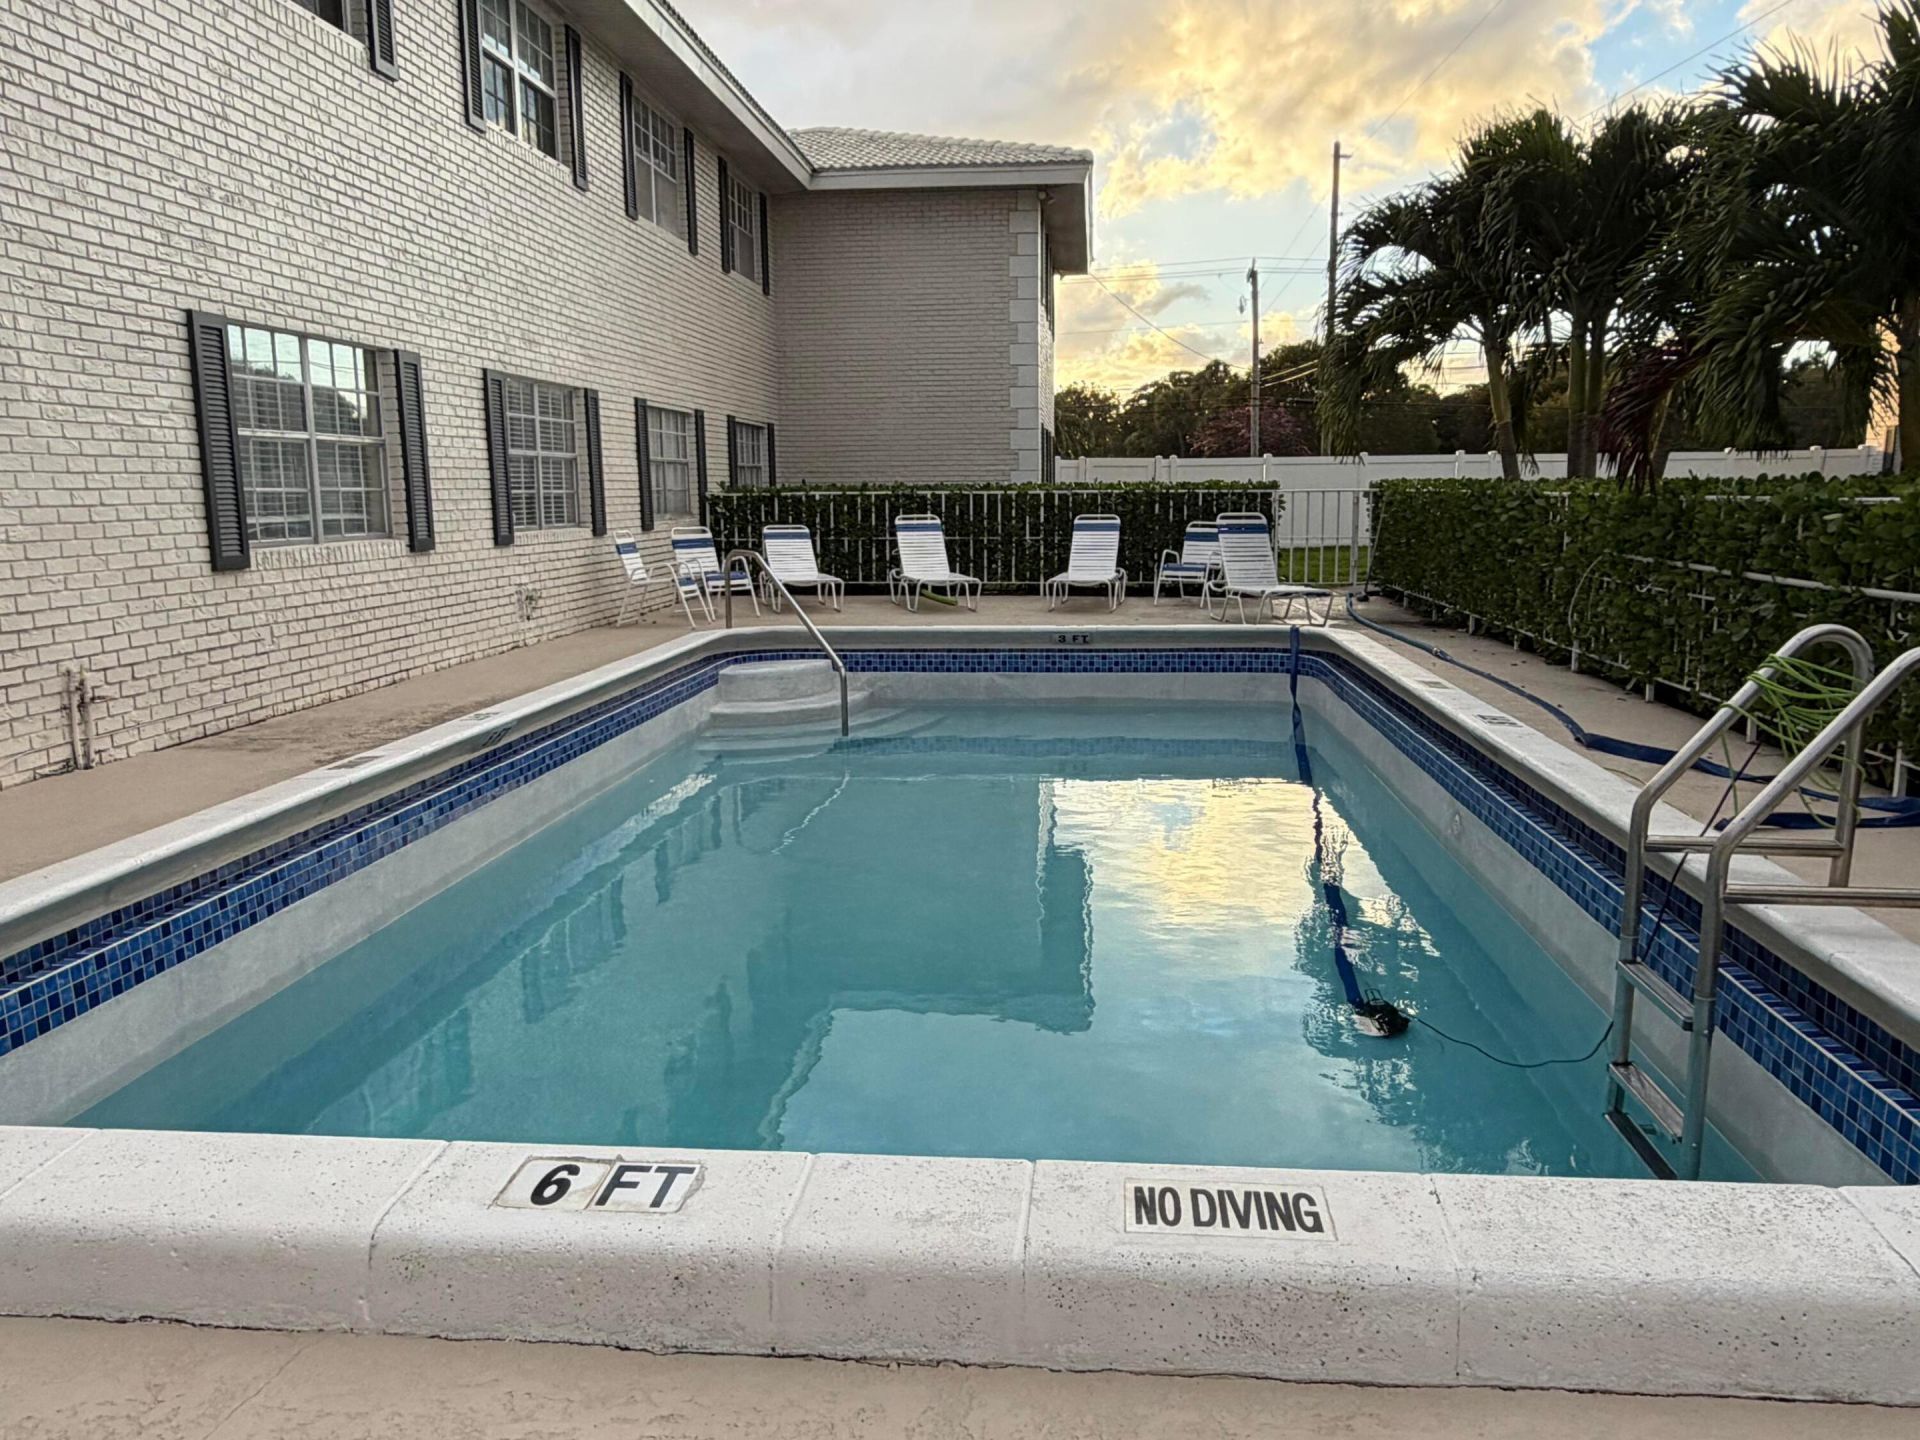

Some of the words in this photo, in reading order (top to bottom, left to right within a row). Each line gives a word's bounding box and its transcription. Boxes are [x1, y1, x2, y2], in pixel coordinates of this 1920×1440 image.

[1058, 634, 1067, 644] 3
[1072, 634, 1089, 645] FT
[530, 1164, 581, 1206] 6
[595, 1165, 697, 1209] FT
[1133, 1185, 1182, 1228] NO
[1189, 1187, 1325, 1233] DIVING
